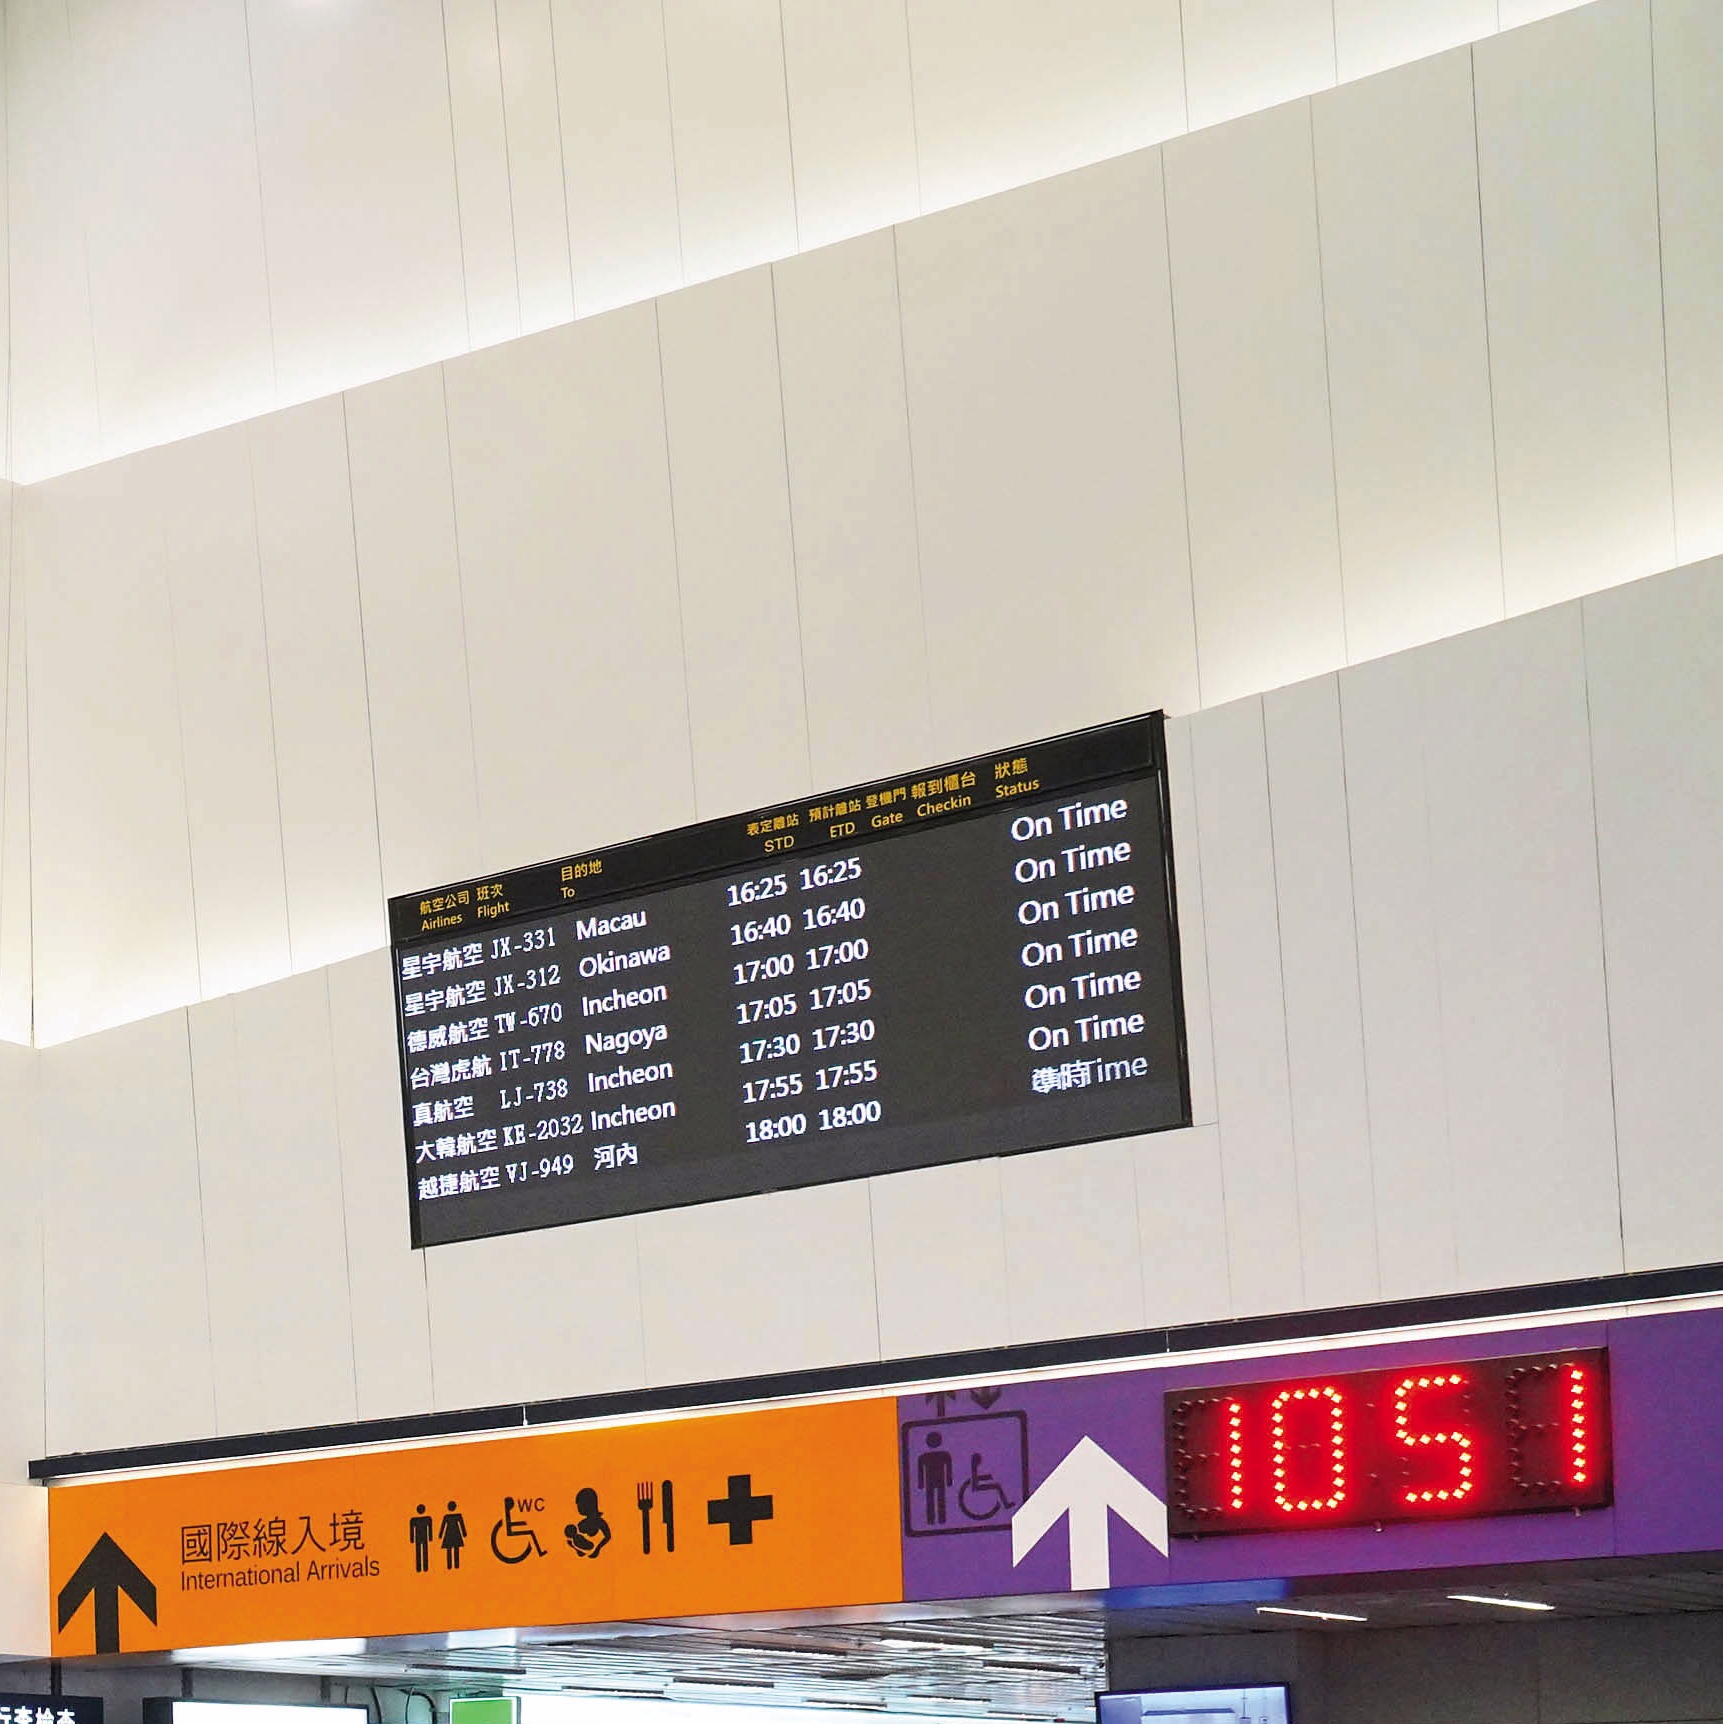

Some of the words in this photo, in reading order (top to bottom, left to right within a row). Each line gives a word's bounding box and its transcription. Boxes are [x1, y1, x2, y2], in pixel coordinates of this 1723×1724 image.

[865, 786, 907, 809] 登機門
[911, 771, 977, 799] 報到櫃台
[994, 757, 1027, 779] 狀態
[995, 777, 1040, 798] Status
[764, 835, 795, 853] STD
[829, 822, 855, 839] ETD
[871, 811, 904, 828] Gate
[916, 794, 972, 817] Checkin
[402, 942, 484, 981] 星宇航空
[490, 928, 556, 959] JX-331
[576, 911, 647, 941] Macau
[727, 874, 788, 907] 16:25
[799, 857, 862, 891] 16:25
[1011, 816, 1052, 842] On
[1058, 798, 1129, 832] Time
[560, 860, 603, 881] 目的地
[560, 886, 575, 899] To
[420, 890, 469, 915] 航空公司
[476, 883, 504, 901] 班次
[421, 913, 463, 931] Airlines
[477, 901, 510, 920] Flight
[404, 980, 487, 1017] 星宇航空
[493, 965, 561, 997] JX-312
[579, 945, 671, 978] Okinawa
[730, 913, 792, 946] 16:40
[803, 898, 866, 931] 16:40
[1014, 858, 1056, 883] On
[1061, 841, 1132, 874] Time
[407, 1017, 490, 1053] 德威航空
[494, 1003, 563, 1034] TW-670
[581, 984, 668, 1017] Incheon
[733, 953, 795, 985] 17:00
[806, 938, 869, 970] 17:00
[1017, 900, 1059, 926] On
[1064, 884, 1136, 916] Time
[410, 1054, 492, 1090] 台灣虎航
[499, 1040, 566, 1072] IT-778
[585, 1024, 668, 1055] Nagoya
[736, 993, 798, 1025] 17:05
[809, 978, 872, 1011] 17:05
[1021, 942, 1063, 968] On
[1067, 926, 1139, 958] Time
[412, 1095, 475, 1127] 真航空
[500, 1078, 569, 1110] LJ-738
[587, 1062, 674, 1093] Incheon
[739, 1033, 801, 1064] 17:30
[812, 1019, 875, 1051] 17:30
[1024, 984, 1066, 1010] On
[1071, 970, 1143, 1001] Time
[415, 1128, 498, 1164] 大韓航空
[503, 1114, 584, 1147] KE-2032
[590, 1100, 676, 1131] Incheon
[742, 1073, 803, 1104] 17:55
[815, 1060, 878, 1091] 17:55
[1028, 1025, 1070, 1052] On
[1074, 1013, 1146, 1044] Time
[418, 1166, 501, 1201] 越捷航空
[506, 1154, 574, 1183] VJ-949
[745, 1113, 807, 1144] 18:00
[818, 1100, 882, 1131] 18:00
[517, 1497, 546, 1513] WC
[181, 1509, 365, 1565] 國際線入境
[181, 1561, 300, 1592] International
[306, 1556, 380, 1581] Arrivals
